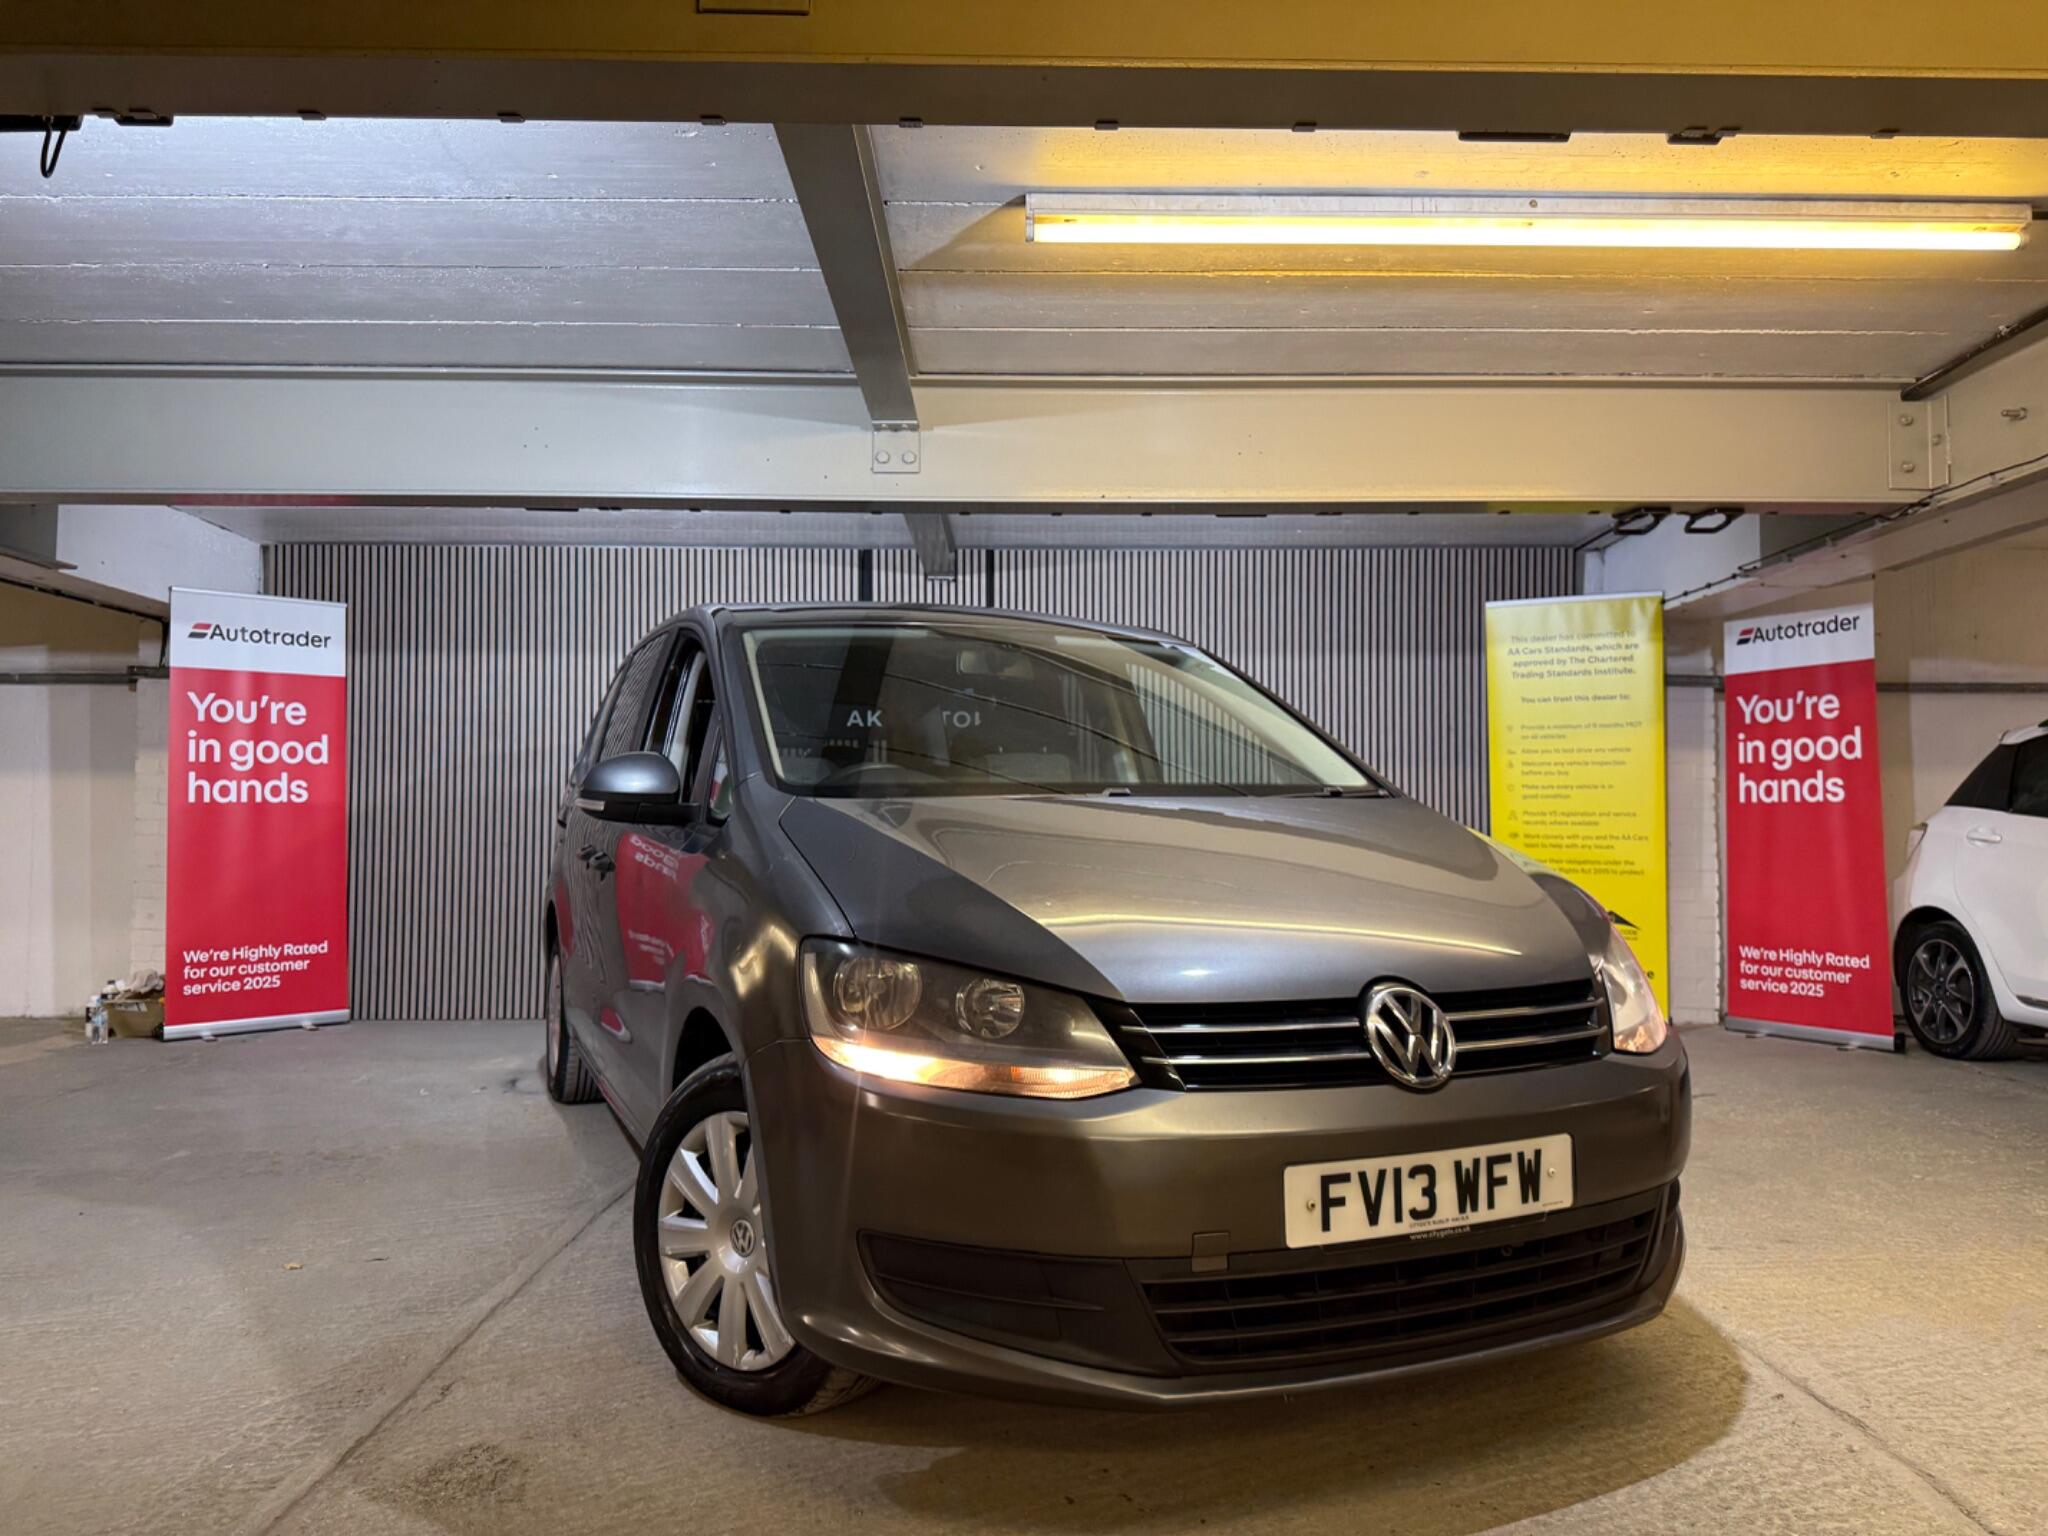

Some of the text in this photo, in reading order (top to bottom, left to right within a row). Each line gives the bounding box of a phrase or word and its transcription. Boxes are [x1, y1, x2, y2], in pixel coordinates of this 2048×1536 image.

[210, 624, 331, 648] Autotrader
[1752, 616, 1860, 644] Autotrader
[1507, 648, 1520, 656] AA
[1595, 643, 1622, 651] which
[1513, 654, 1634, 668] approved by The Chartered
[1512, 671, 1544, 679] Trading
[1546, 668, 1592, 677] Standards
[187, 692, 307, 726] You're
[848, 710, 882, 728] AK
[1736, 690, 1840, 724] You're
[188, 730, 328, 771] in good
[1738, 726, 1862, 771] in good
[188, 772, 308, 803] hands
[1739, 770, 1845, 804] hands
[183, 941, 328, 964] We're Highly Rated
[1739, 945, 1870, 969] We're Highly Rated
[184, 959, 310, 980] for our customer
[1740, 960, 1852, 984] for our customer
[183, 976, 280, 996] service 2025
[1740, 978, 1824, 997] service 2025
[1320, 1148, 1542, 1232] FV13 WFW
